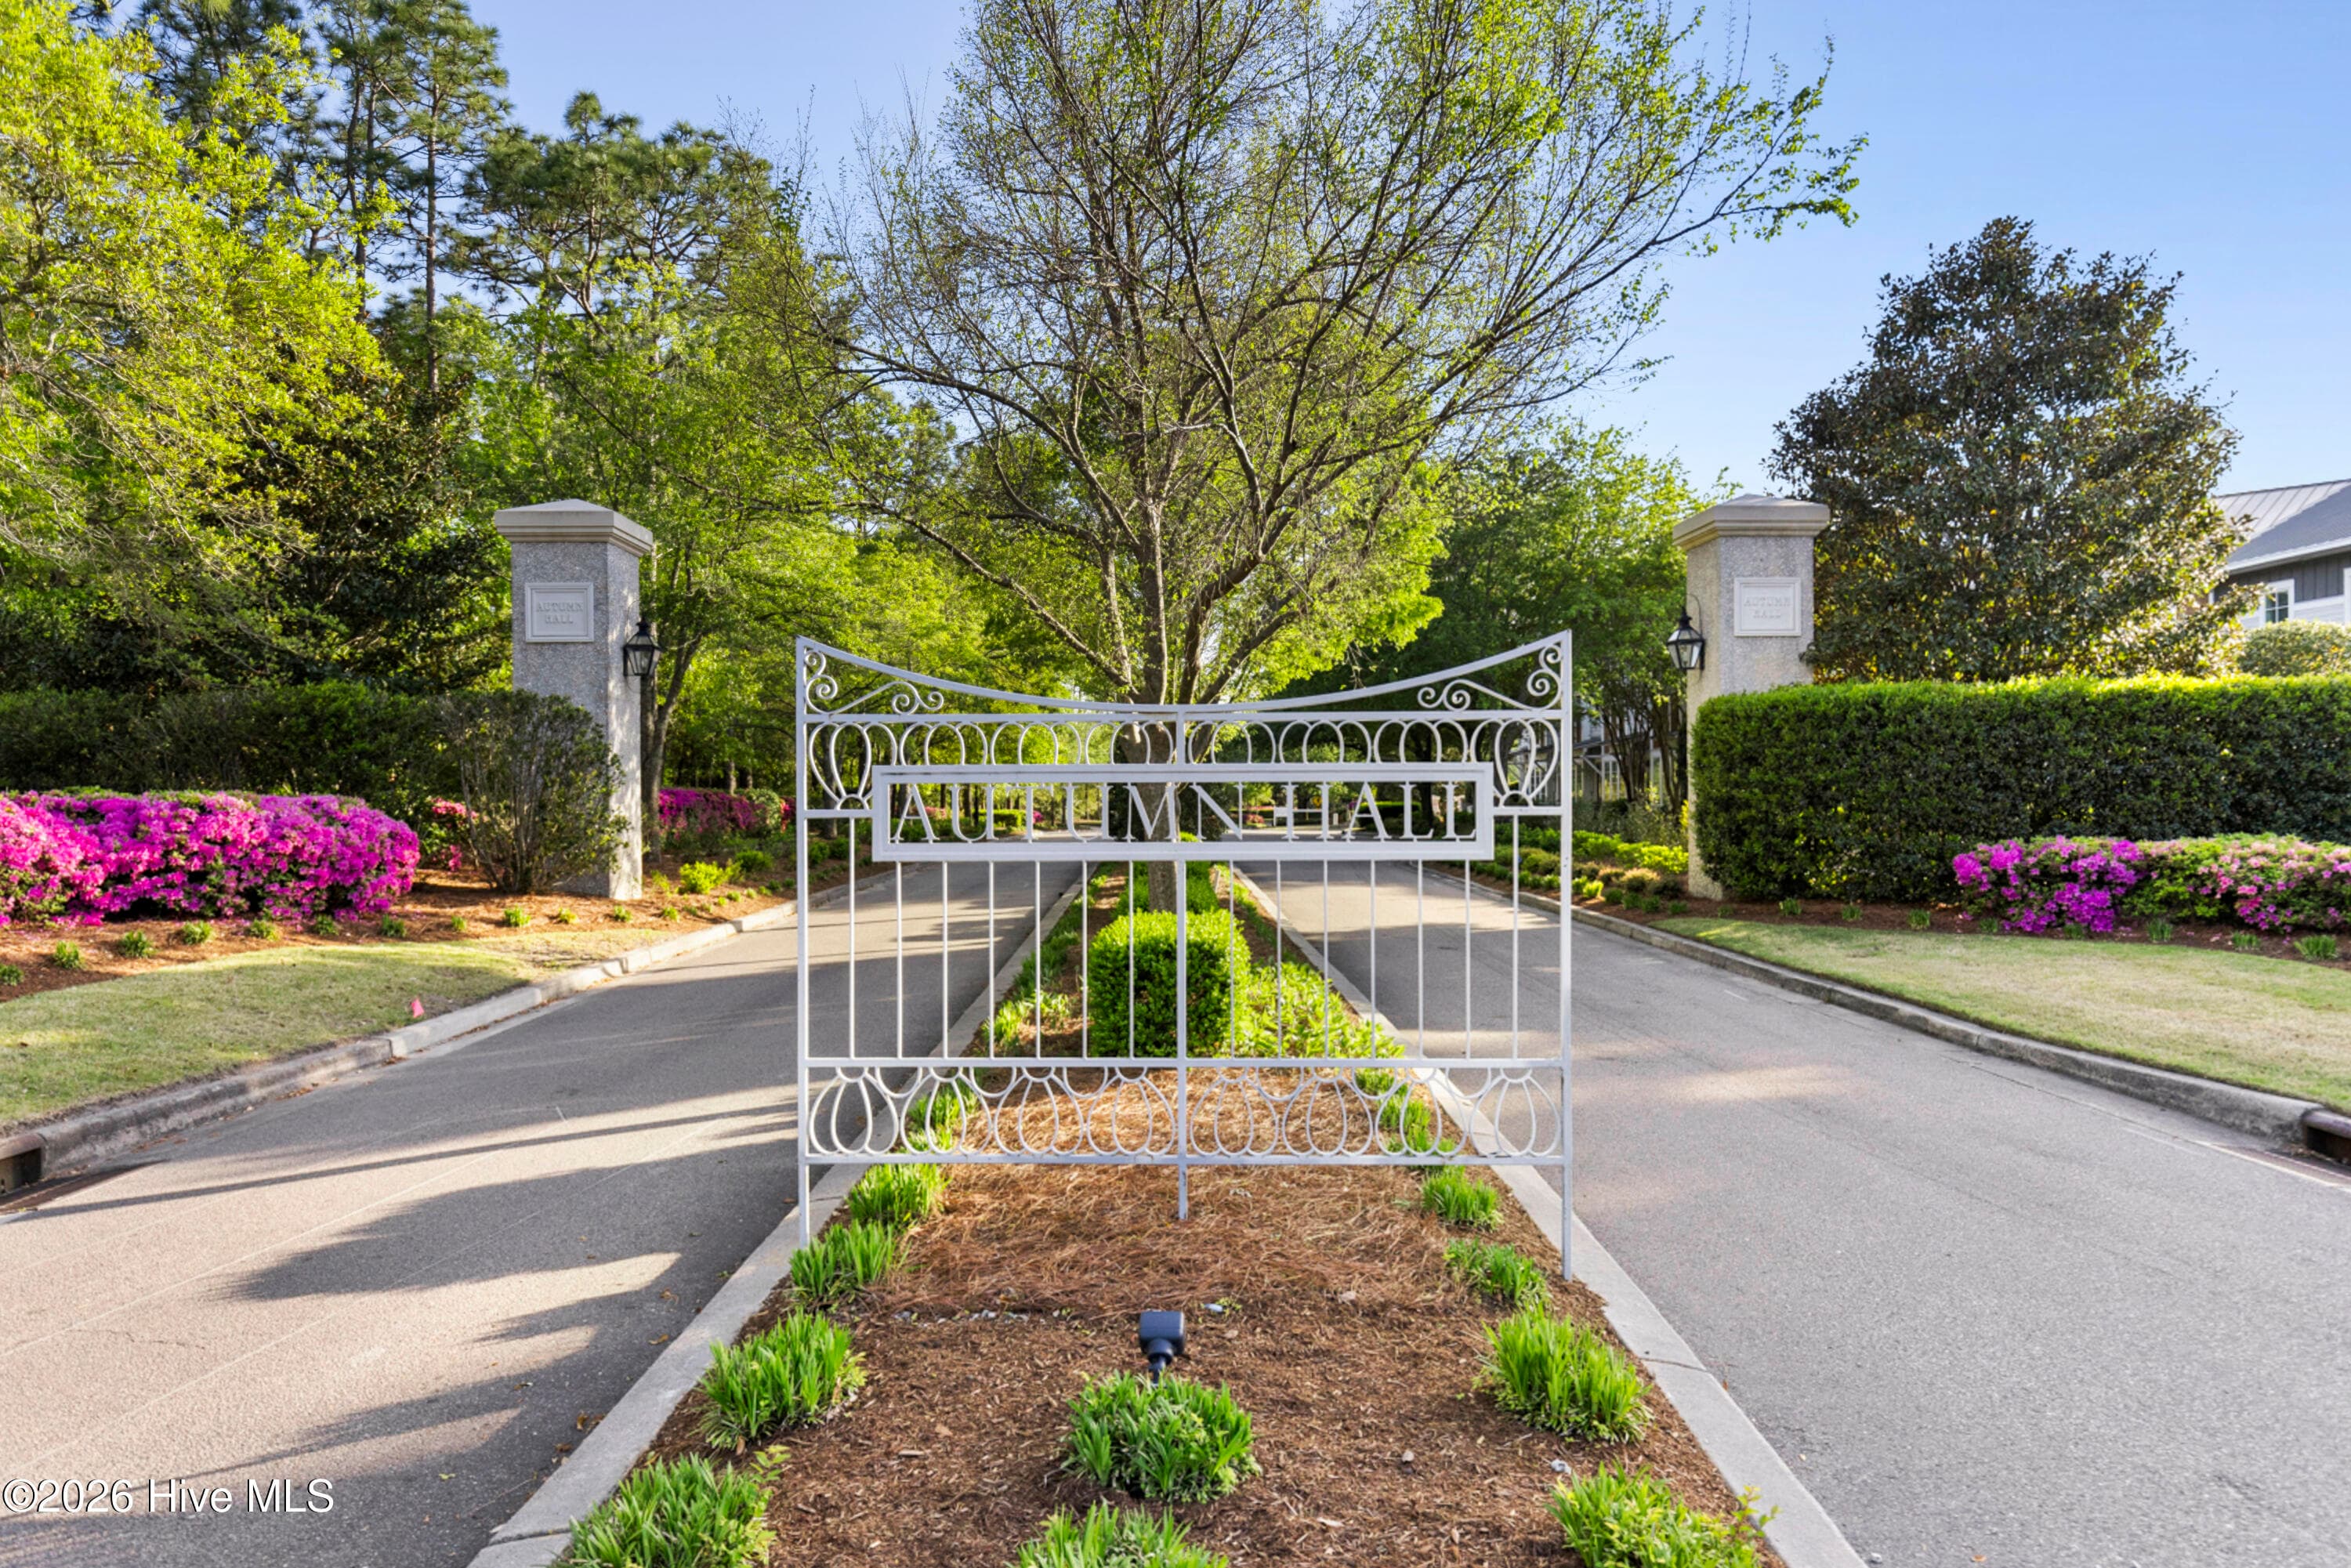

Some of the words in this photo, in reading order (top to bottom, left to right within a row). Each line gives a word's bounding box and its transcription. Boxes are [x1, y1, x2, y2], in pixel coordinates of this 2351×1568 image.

[537, 602, 583, 612] AUTUMN
[891, 783, 1244, 843] AUTUMN
[1281, 783, 1476, 843] HALL
